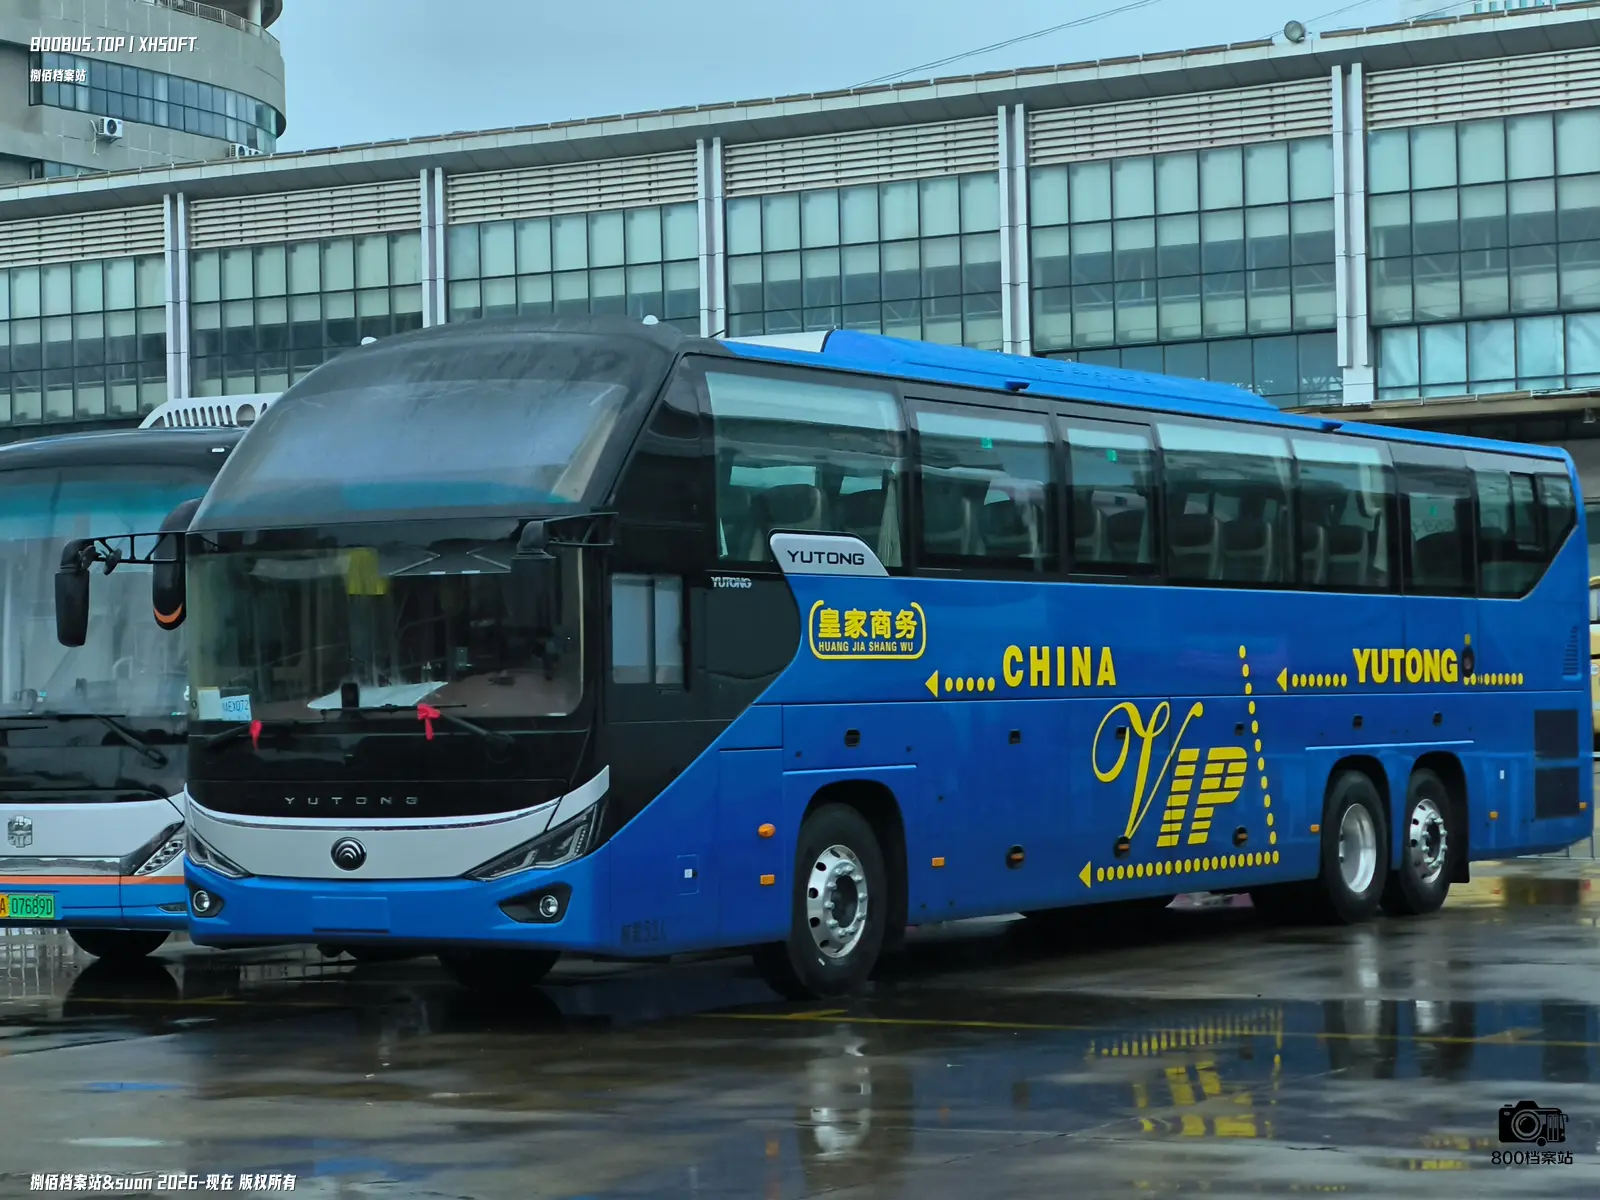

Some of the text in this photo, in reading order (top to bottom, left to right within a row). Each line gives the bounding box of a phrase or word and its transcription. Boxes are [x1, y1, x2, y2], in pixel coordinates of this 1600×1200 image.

[787, 550, 865, 566] YUTONG
[711, 576, 752, 589] YUTONG
[818, 608, 917, 639] 皇家商务
[818, 642, 914, 652] HUANG JIA SHANG WU
[1002, 644, 1117, 687] CHINA
[1352, 647, 1459, 684] YUTONG
[1092, 701, 1248, 848] VIP
[284, 796, 418, 805] YUTONG
